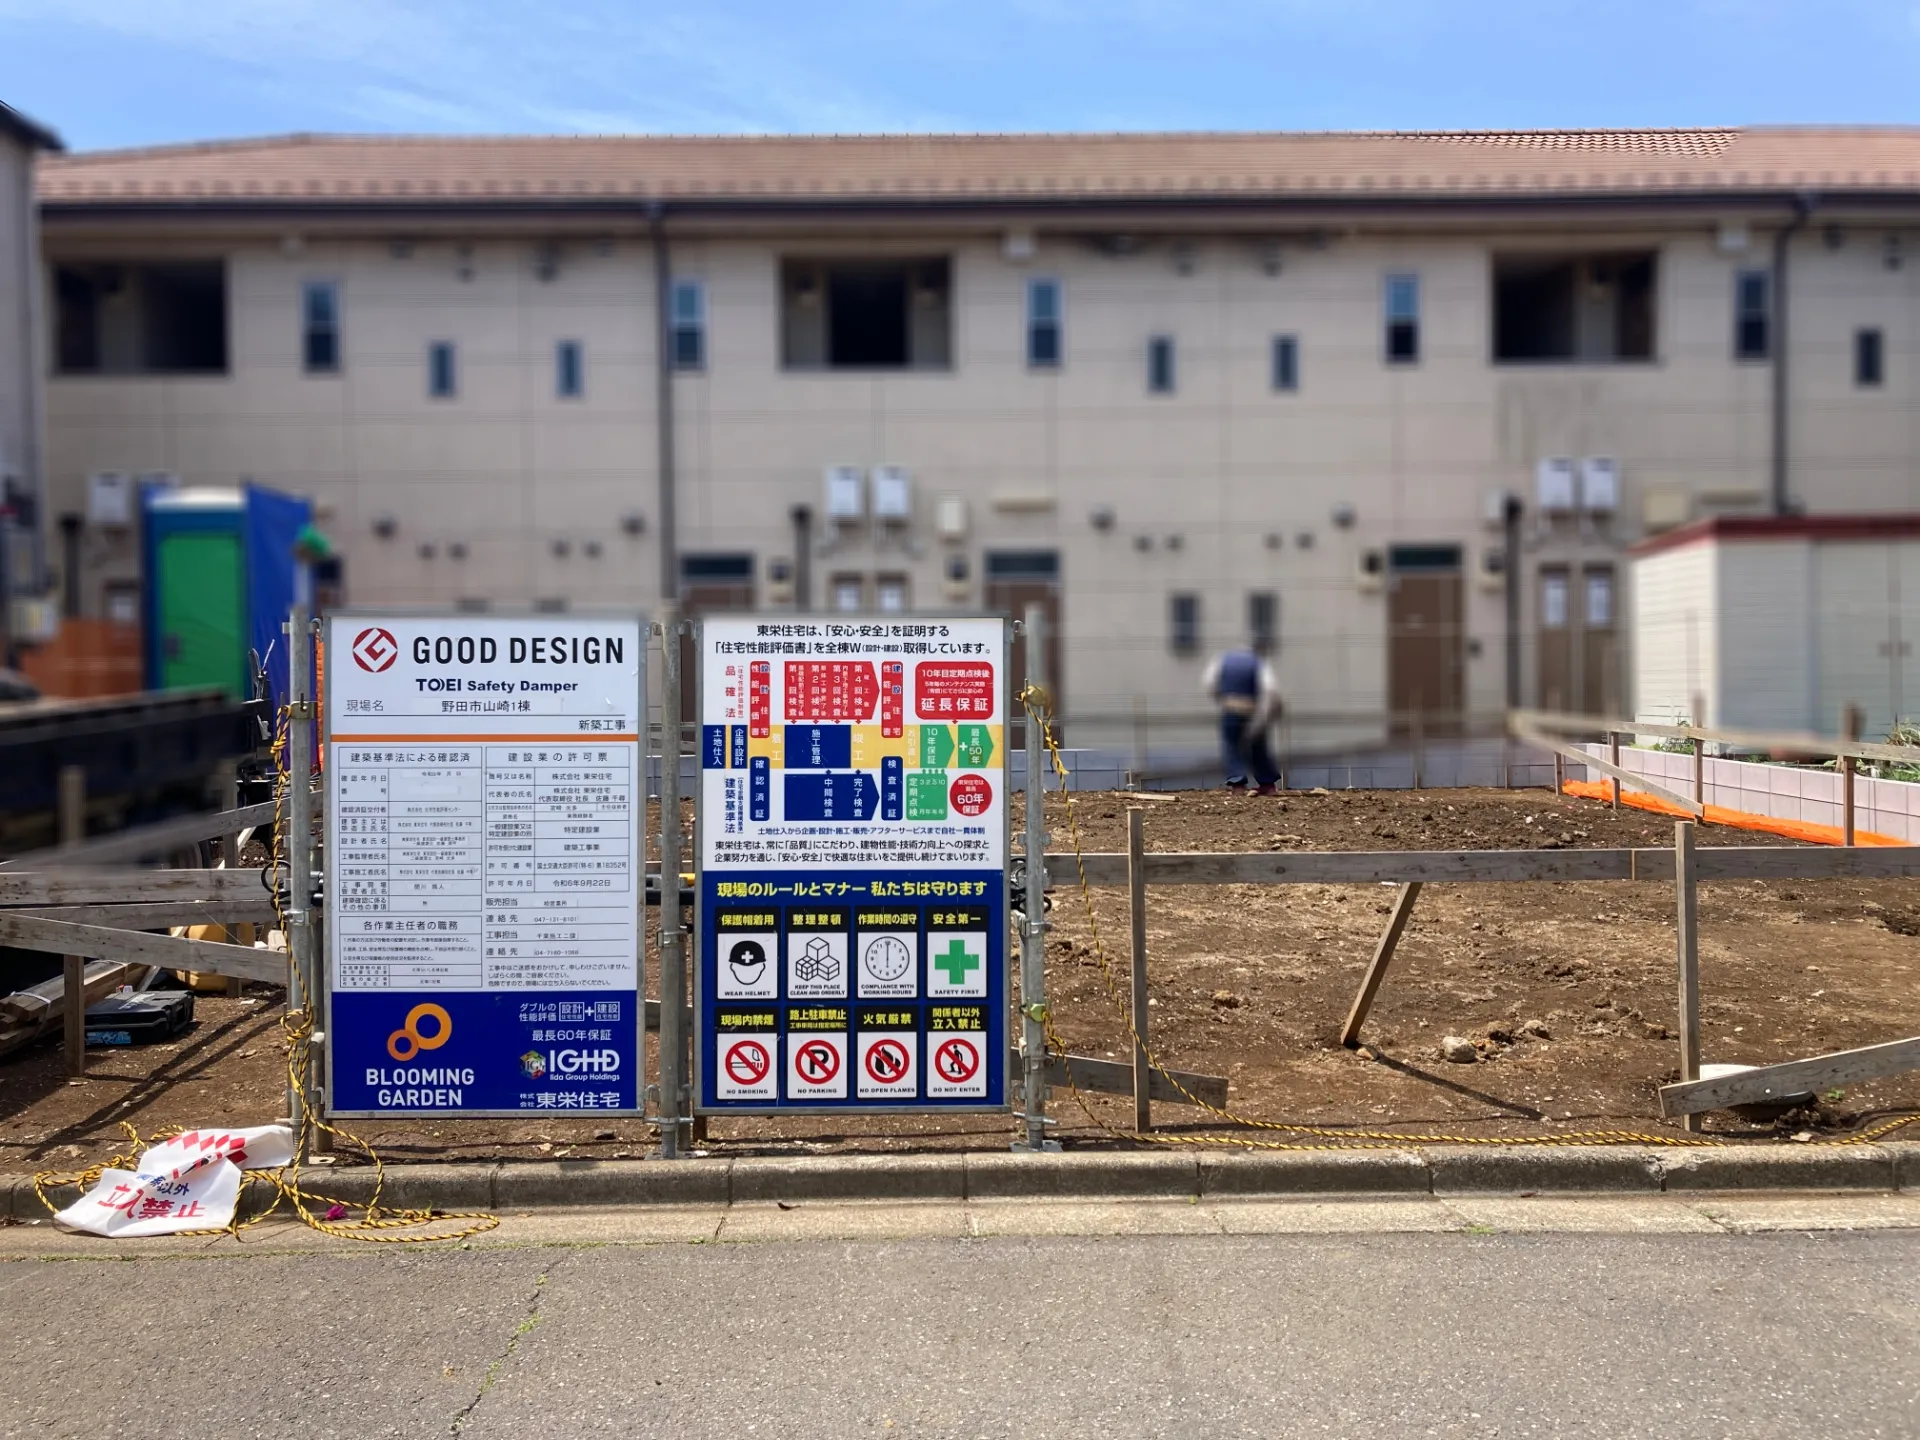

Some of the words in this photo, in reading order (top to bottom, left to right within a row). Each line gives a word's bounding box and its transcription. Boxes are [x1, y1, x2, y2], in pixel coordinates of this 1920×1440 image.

[757, 625, 949, 637] 東栄住宅は、「安心・安全」を証明する
[413, 637, 497, 664] GOOD
[509, 637, 624, 664] DESIGN
[415, 678, 462, 692] TOEI
[467, 680, 515, 694] Safety
[520, 681, 578, 693] Damper
[725, 665, 736, 718] 品確法
[346, 700, 384, 712] 現場名
[441, 700, 531, 713] 野田市山崎1棟
[921, 697, 988, 712] 延長保証
[578, 719, 626, 731] 新築工事
[713, 728, 722, 765] 土地仕入
[734, 728, 744, 766] 企画・設計
[811, 729, 821, 765] 施工管理
[927, 727, 938, 764] 10年保証
[351, 752, 470, 763] 建築基準法による確認済
[508, 752, 608, 762] 建設業の許可票
[552, 773, 580, 781] 株式会社
[755, 760, 765, 819] 確認済証
[887, 759, 897, 818] 検査済証
[824, 778, 833, 818] 中間検査
[853, 778, 863, 817] 完了検査
[909, 777, 918, 816] 定期点検
[957, 793, 984, 805] 60年
[725, 778, 736, 834] 建築基準法
[963, 805, 979, 814] 保証
[553, 879, 611, 887] 令和6年9月22日
[717, 882, 867, 897] 現場のルールとマナー
[871, 880, 988, 896] 私たちは守ります
[486, 898, 518, 906] 販売担当
[722, 914, 775, 926] 保護帽着用
[792, 914, 842, 925] 整理整頓
[858, 913, 918, 925] 作業時間の遵守
[932, 913, 982, 925] 安全第一
[364, 921, 458, 931] 各作業主任者の職務
[486, 931, 518, 939] 工事担当
[486, 948, 518, 956] 連絡先
[520, 1003, 556, 1012] ダブルの
[561, 1004, 582, 1014] 設計
[597, 1004, 618, 1014] 建設
[932, 1008, 980, 1017] 関係者以外
[519, 1012, 556, 1021] 性能評価
[720, 1014, 774, 1026] 現場内禁煙
[789, 1009, 847, 1020] 路上駐車禁止
[863, 1013, 912, 1025] 火気厳禁
[932, 1018, 981, 1029] 立入禁止
[532, 1029, 612, 1041] 最長60年保証
[550, 1049, 620, 1073] IGHD
[366, 1069, 474, 1085] BLOOMING
[589, 1073, 620, 1081] Holdings
[378, 1090, 462, 1106] GARDEN
[536, 1092, 620, 1108] 東栄住宅
[97, 1183, 206, 1219] 立入禁止
